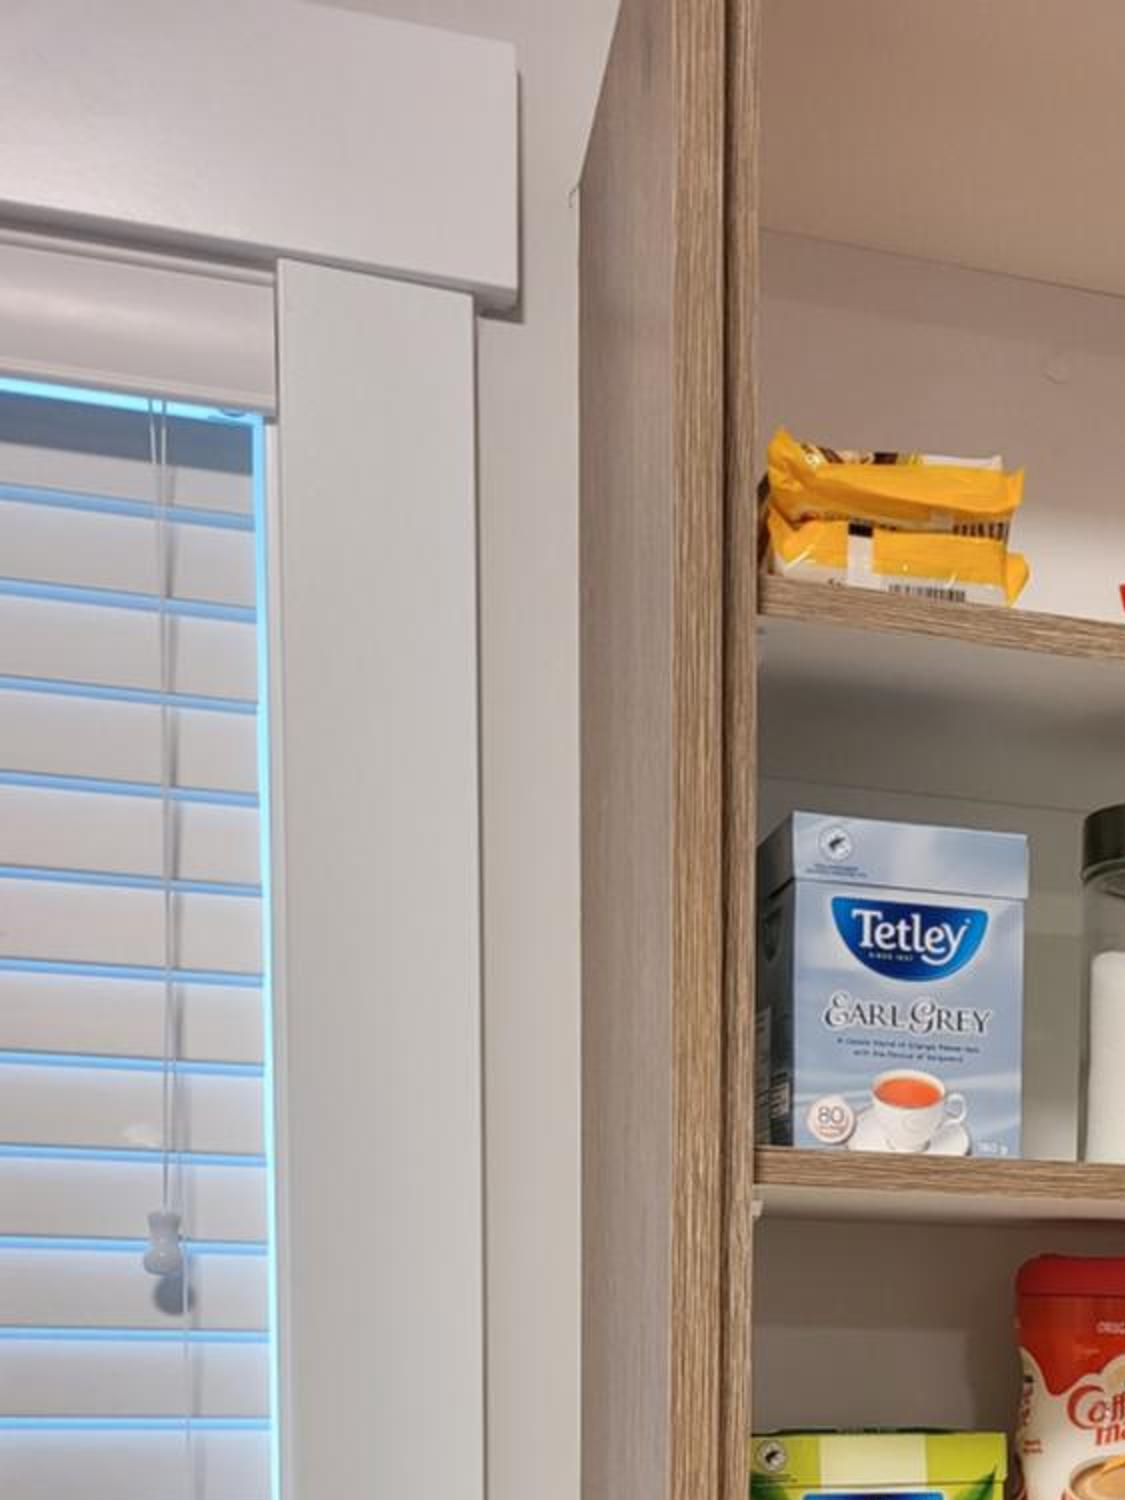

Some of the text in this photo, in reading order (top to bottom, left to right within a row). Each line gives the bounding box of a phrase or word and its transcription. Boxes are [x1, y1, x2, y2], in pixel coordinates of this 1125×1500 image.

[852, 908, 968, 966] Tetley
[824, 991, 991, 1034] EARL GREY
[818, 1106, 844, 1124] 80
